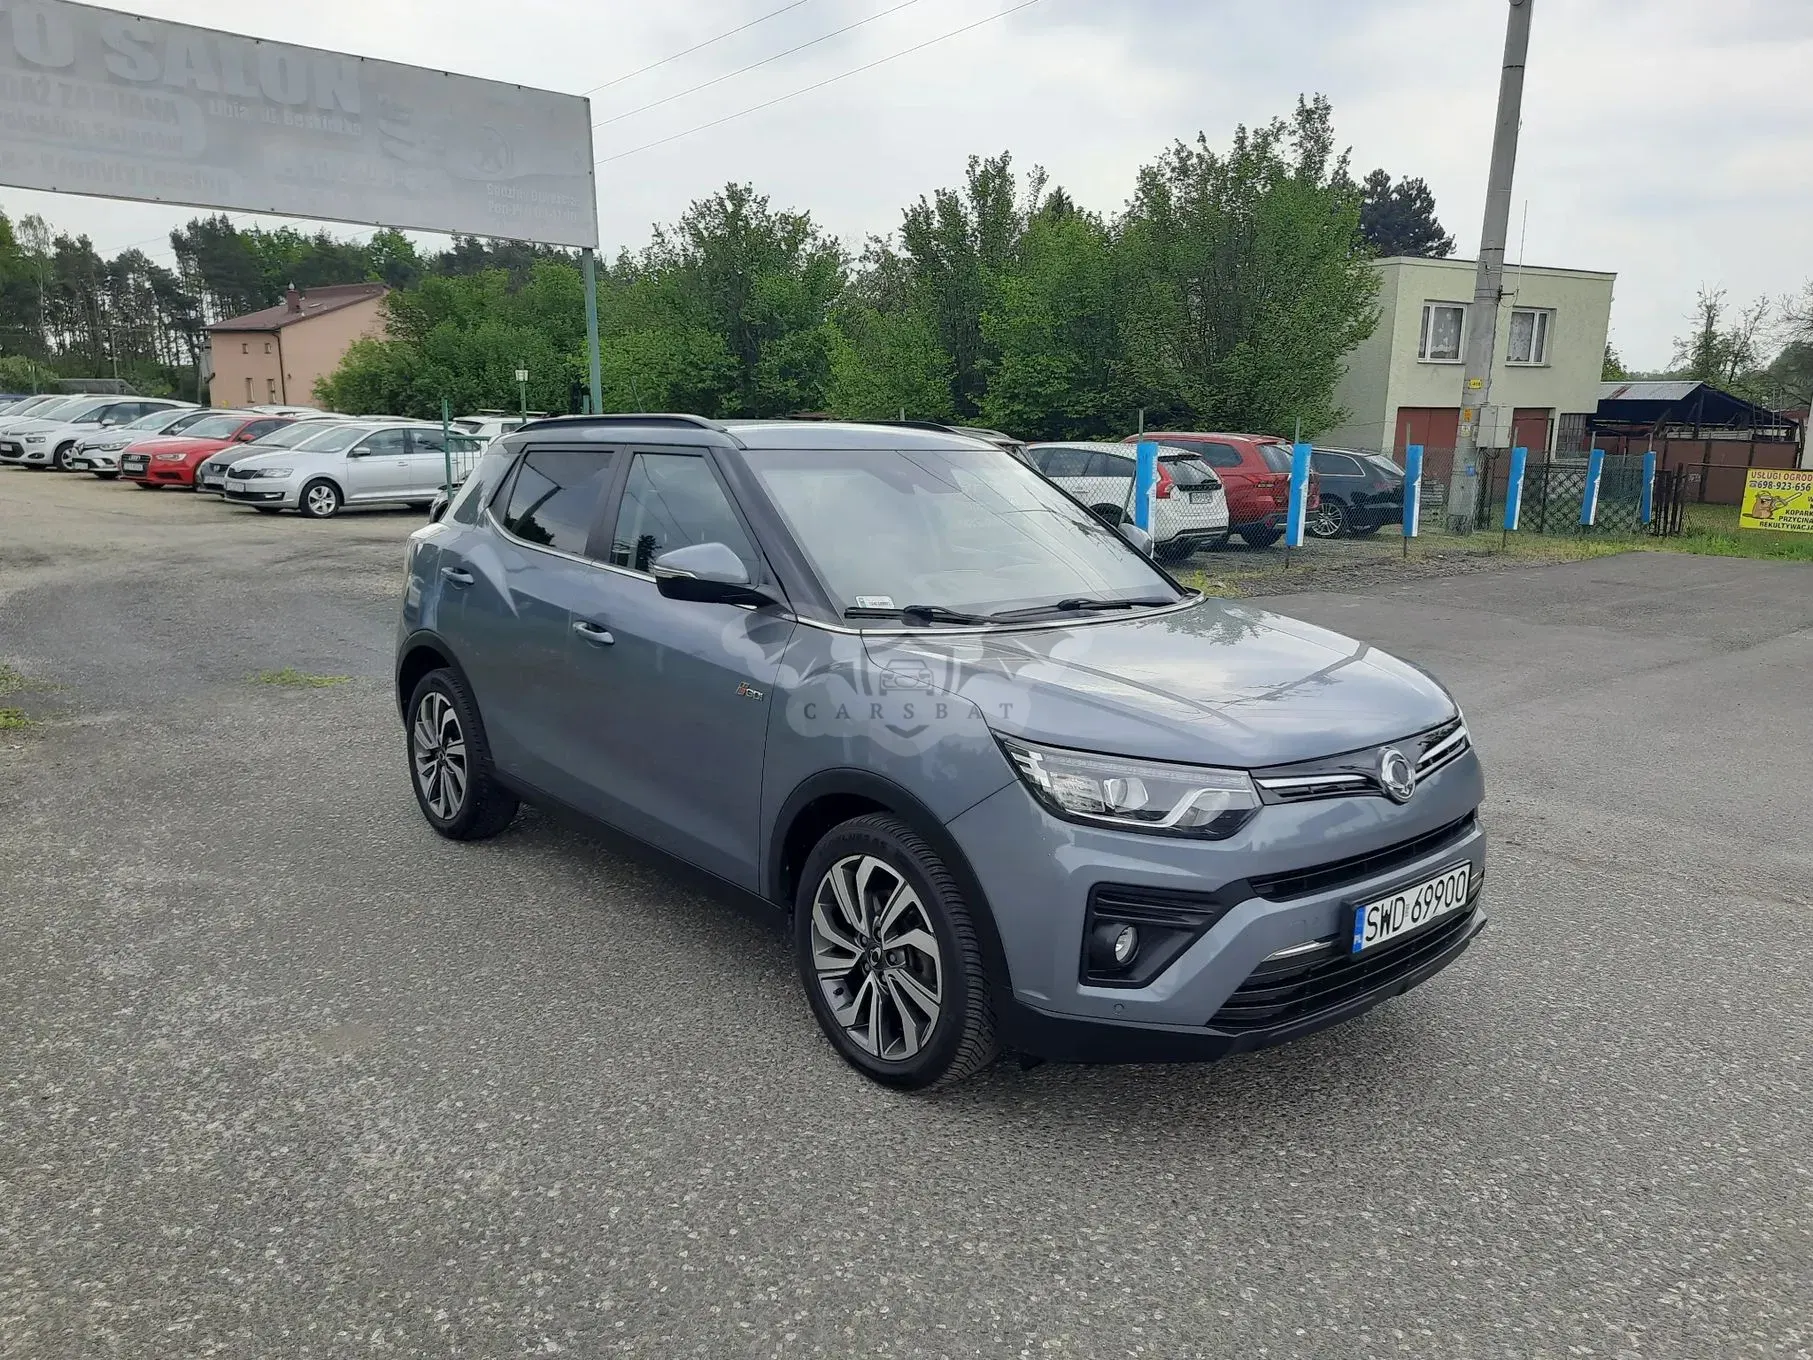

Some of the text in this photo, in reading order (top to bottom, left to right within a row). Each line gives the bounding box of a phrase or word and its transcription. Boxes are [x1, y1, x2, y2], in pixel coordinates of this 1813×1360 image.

[101, 17, 362, 114] SALON
[1751, 471, 1781, 480] USŁUGI
[1757, 481, 1811, 491] 698-923-656
[1365, 870, 1466, 942] SWD 69900
